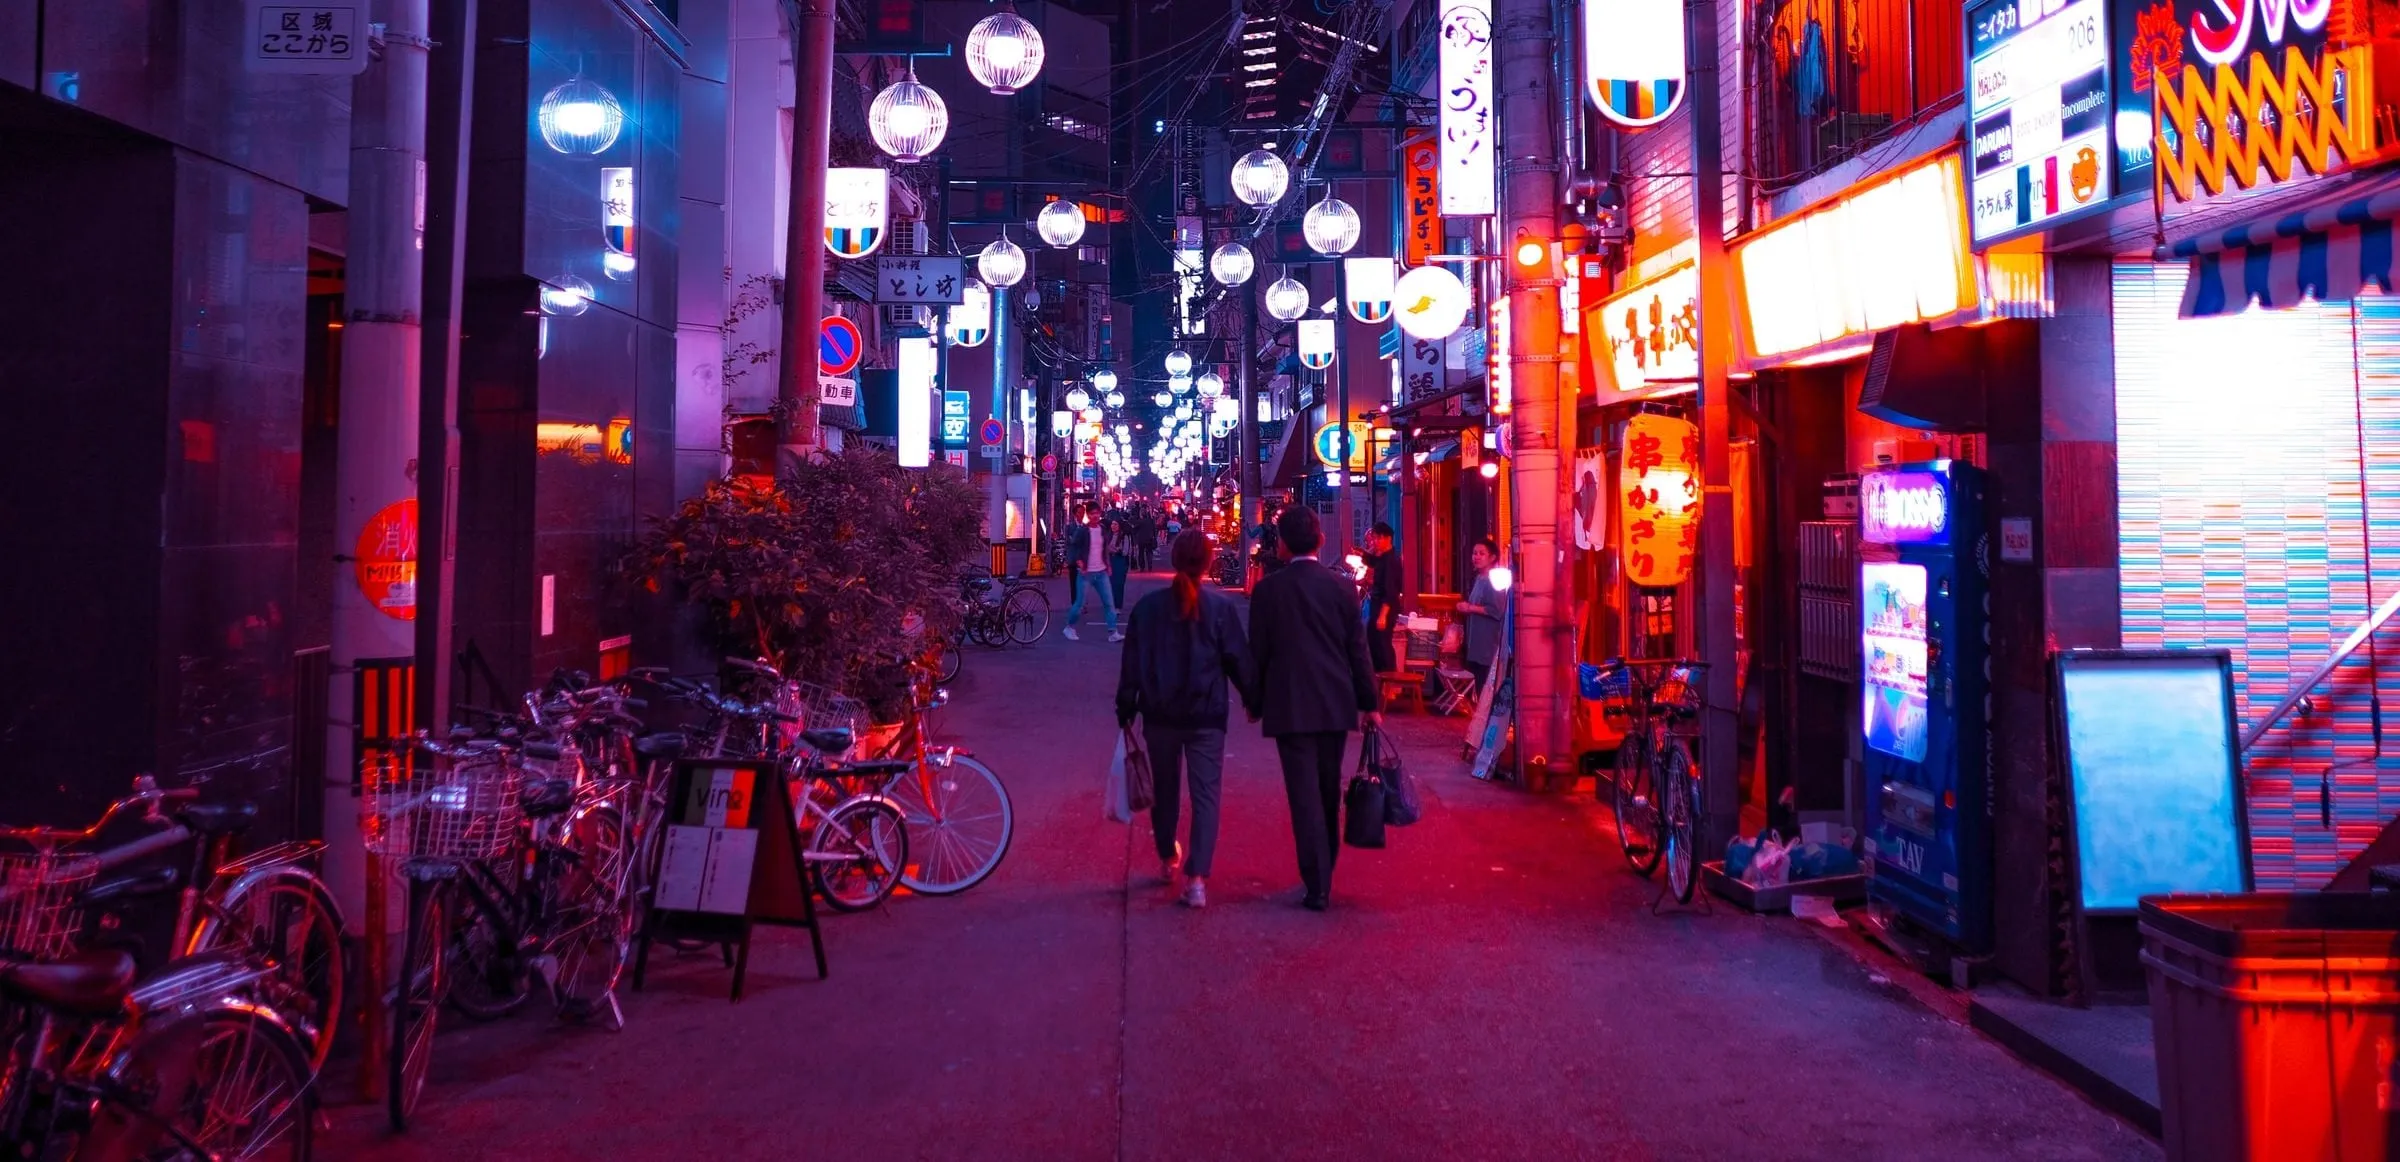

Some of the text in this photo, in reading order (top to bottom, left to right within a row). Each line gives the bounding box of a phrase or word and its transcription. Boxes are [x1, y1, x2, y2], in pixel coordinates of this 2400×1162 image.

[281, 11, 332, 31] 区域
[1977, 3, 2017, 42] ニイタカ
[2068, 15, 2096, 53] 206
[262, 34, 349, 53] ここから
[2060, 89, 2107, 120] incomplete
[1976, 125, 2012, 158] DARUMA
[1977, 188, 2014, 220] うちん家
[881, 259, 921, 271] 小料理
[889, 274, 958, 298] とし坊
[819, 383, 854, 401] 動車
[1627, 432, 1664, 578] 串かざり
